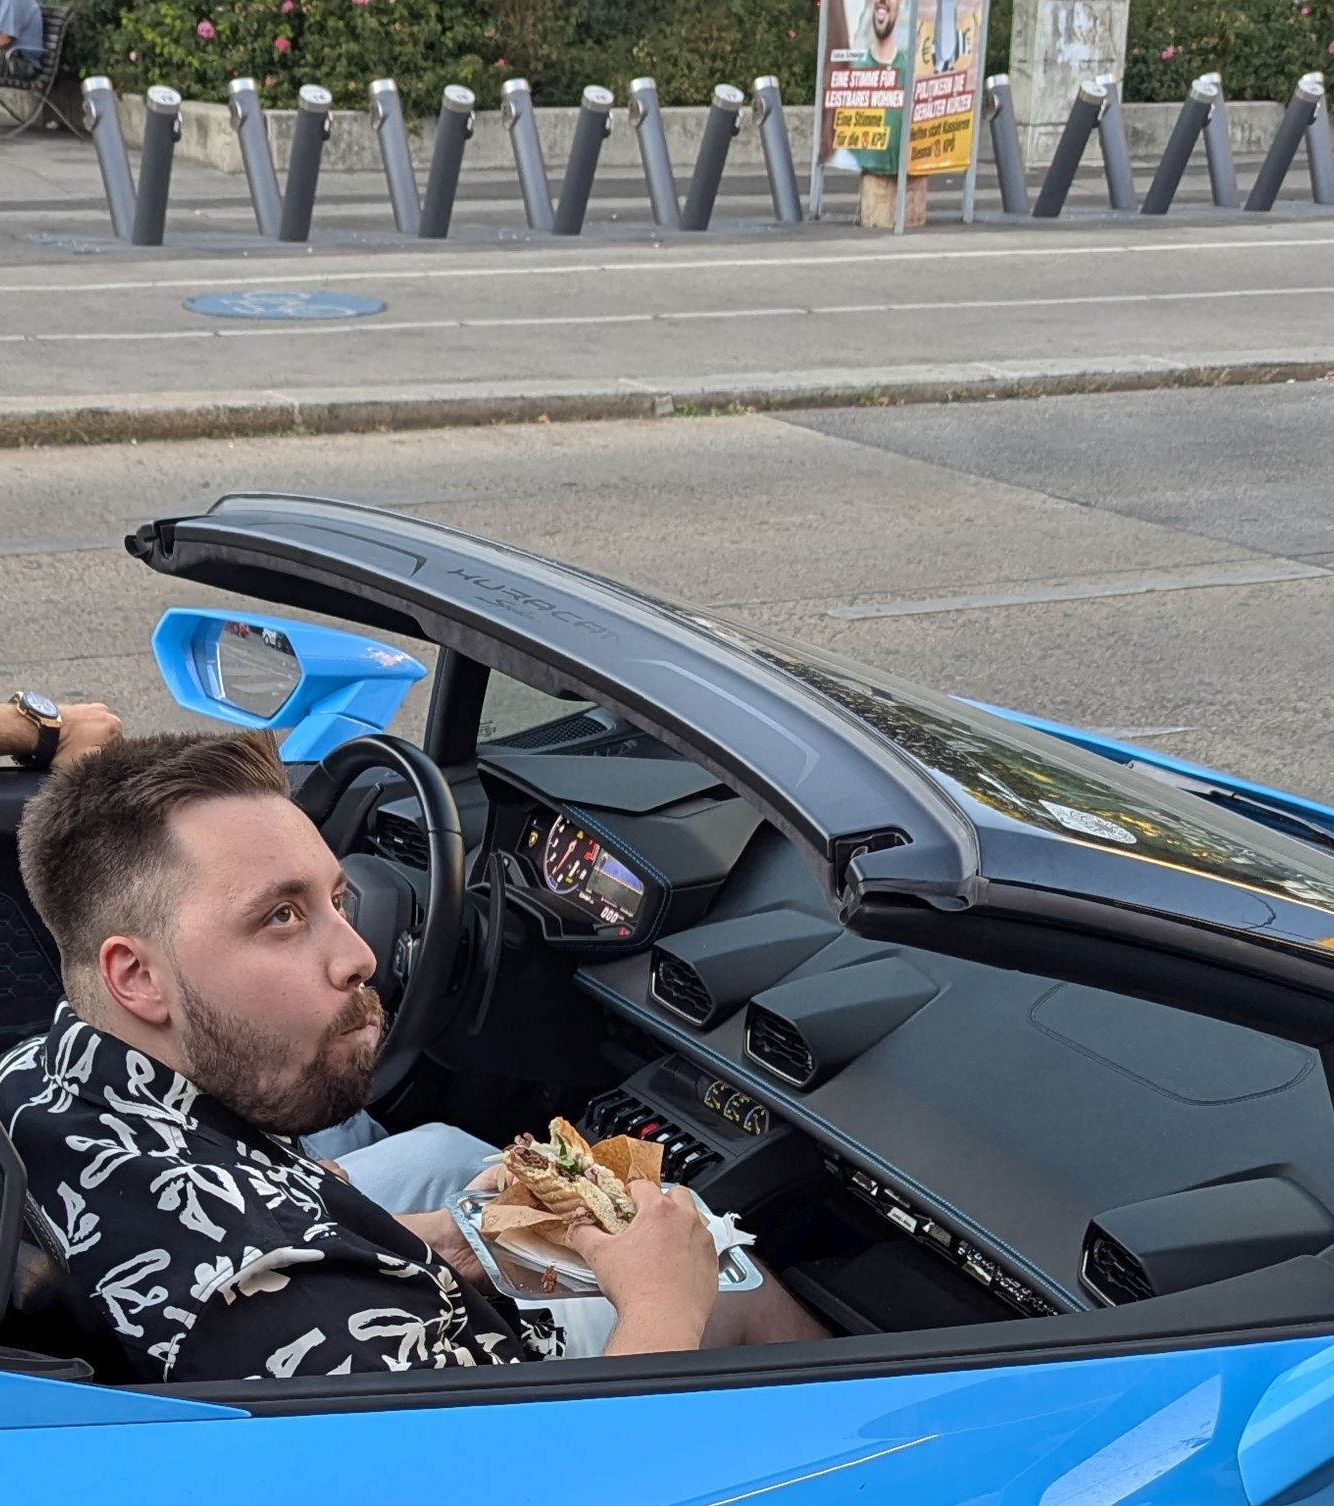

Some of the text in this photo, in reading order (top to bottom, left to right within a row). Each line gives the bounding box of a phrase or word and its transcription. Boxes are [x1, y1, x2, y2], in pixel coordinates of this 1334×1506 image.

[831, 70, 849, 88] EINE
[849, 70, 879, 88] STIMME
[835, 111, 883, 127] Eine Stimme
[872, 128, 887, 148] KPÖ
